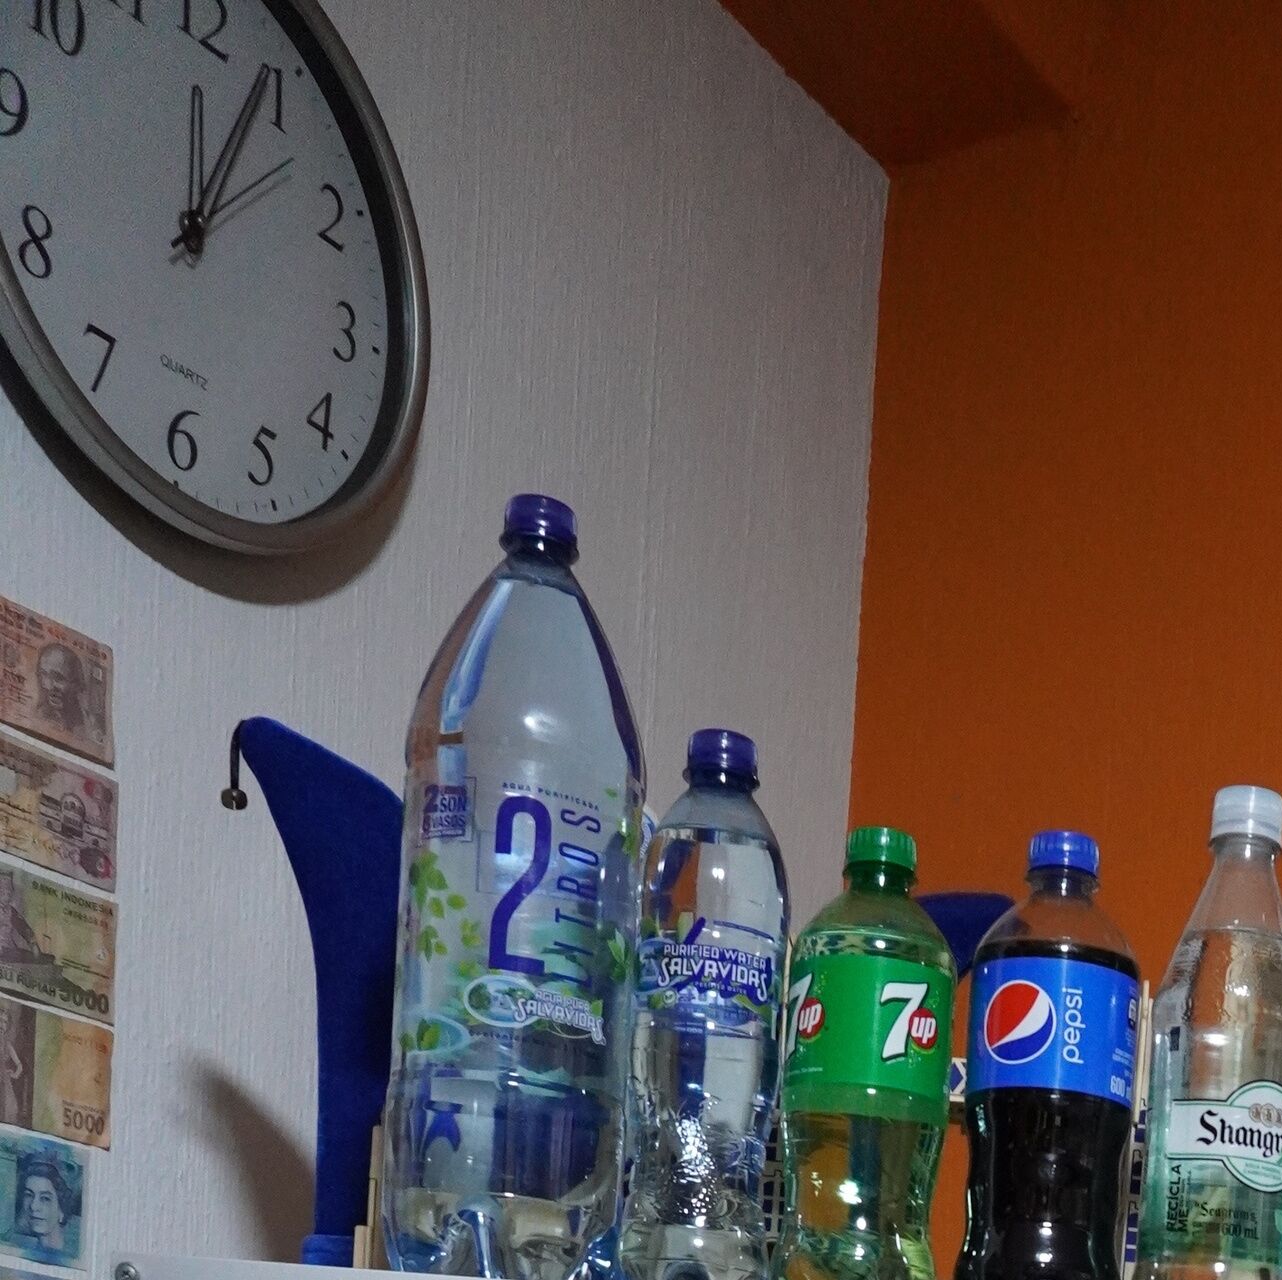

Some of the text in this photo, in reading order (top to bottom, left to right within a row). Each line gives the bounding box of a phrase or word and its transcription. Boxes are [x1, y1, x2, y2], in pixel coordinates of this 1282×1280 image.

[269, 67, 287, 134] 1
[18, 204, 53, 279] 8
[317, 183, 345, 252] 2
[83, 322, 117, 393] 7
[332, 300, 357, 363] 3
[160, 353, 209, 392] QUARTZ
[167, 409, 201, 472] 6
[306, 391, 335, 452] 4
[247, 425, 278, 487] 5
[61, 889, 114, 917] INDONESIA
[663, 943, 722, 959] PURIFIED
[513, 998, 607, 1045] SALVAVIDAS
[1062, 987, 1088, 1065] pepsi
[62, 1106, 105, 1137] 5000
